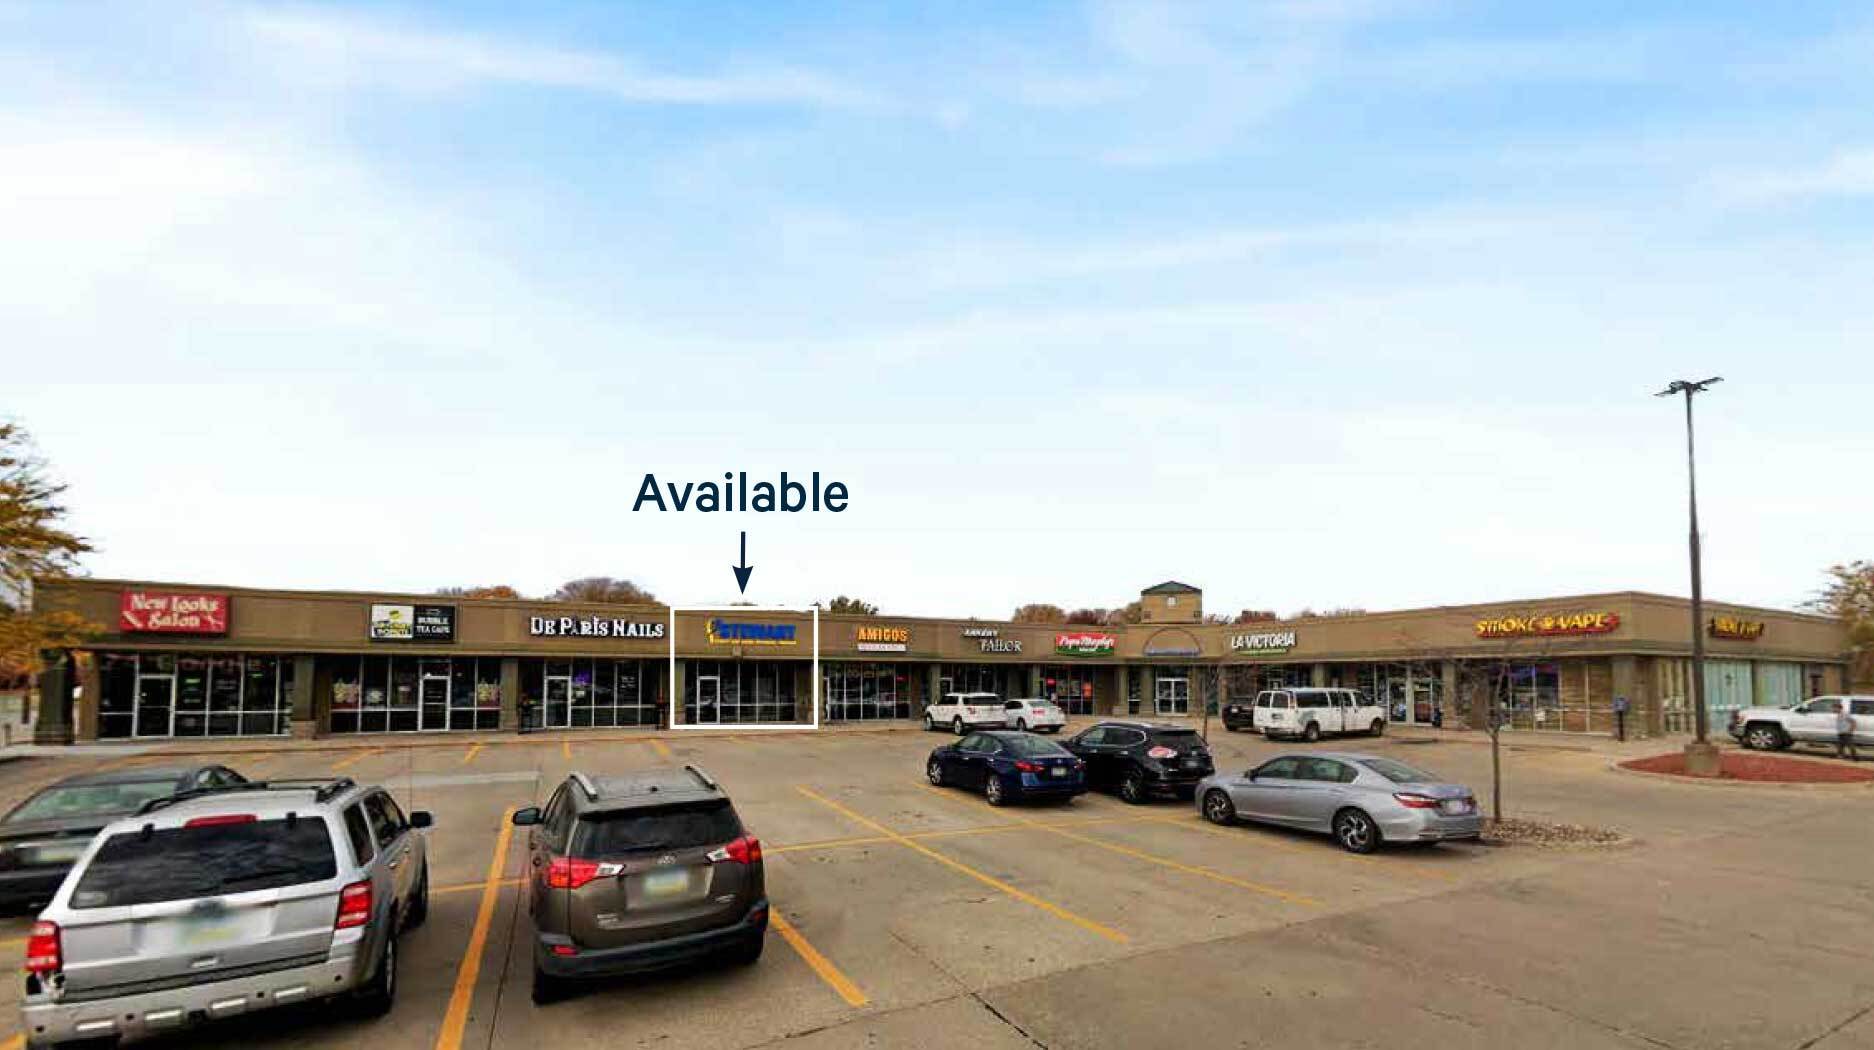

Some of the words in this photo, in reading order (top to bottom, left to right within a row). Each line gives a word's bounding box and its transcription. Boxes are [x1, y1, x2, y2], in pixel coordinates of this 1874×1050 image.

[131, 593, 167, 611] New
[148, 611, 201, 629] Salon
[1475, 616, 1537, 635] SMOKE
[1556, 611, 1606, 630] VAPE
[858, 626, 908, 642] AMIGOS
[1231, 635, 1245, 650] LA
[1246, 631, 1297, 649] VICTORIA
